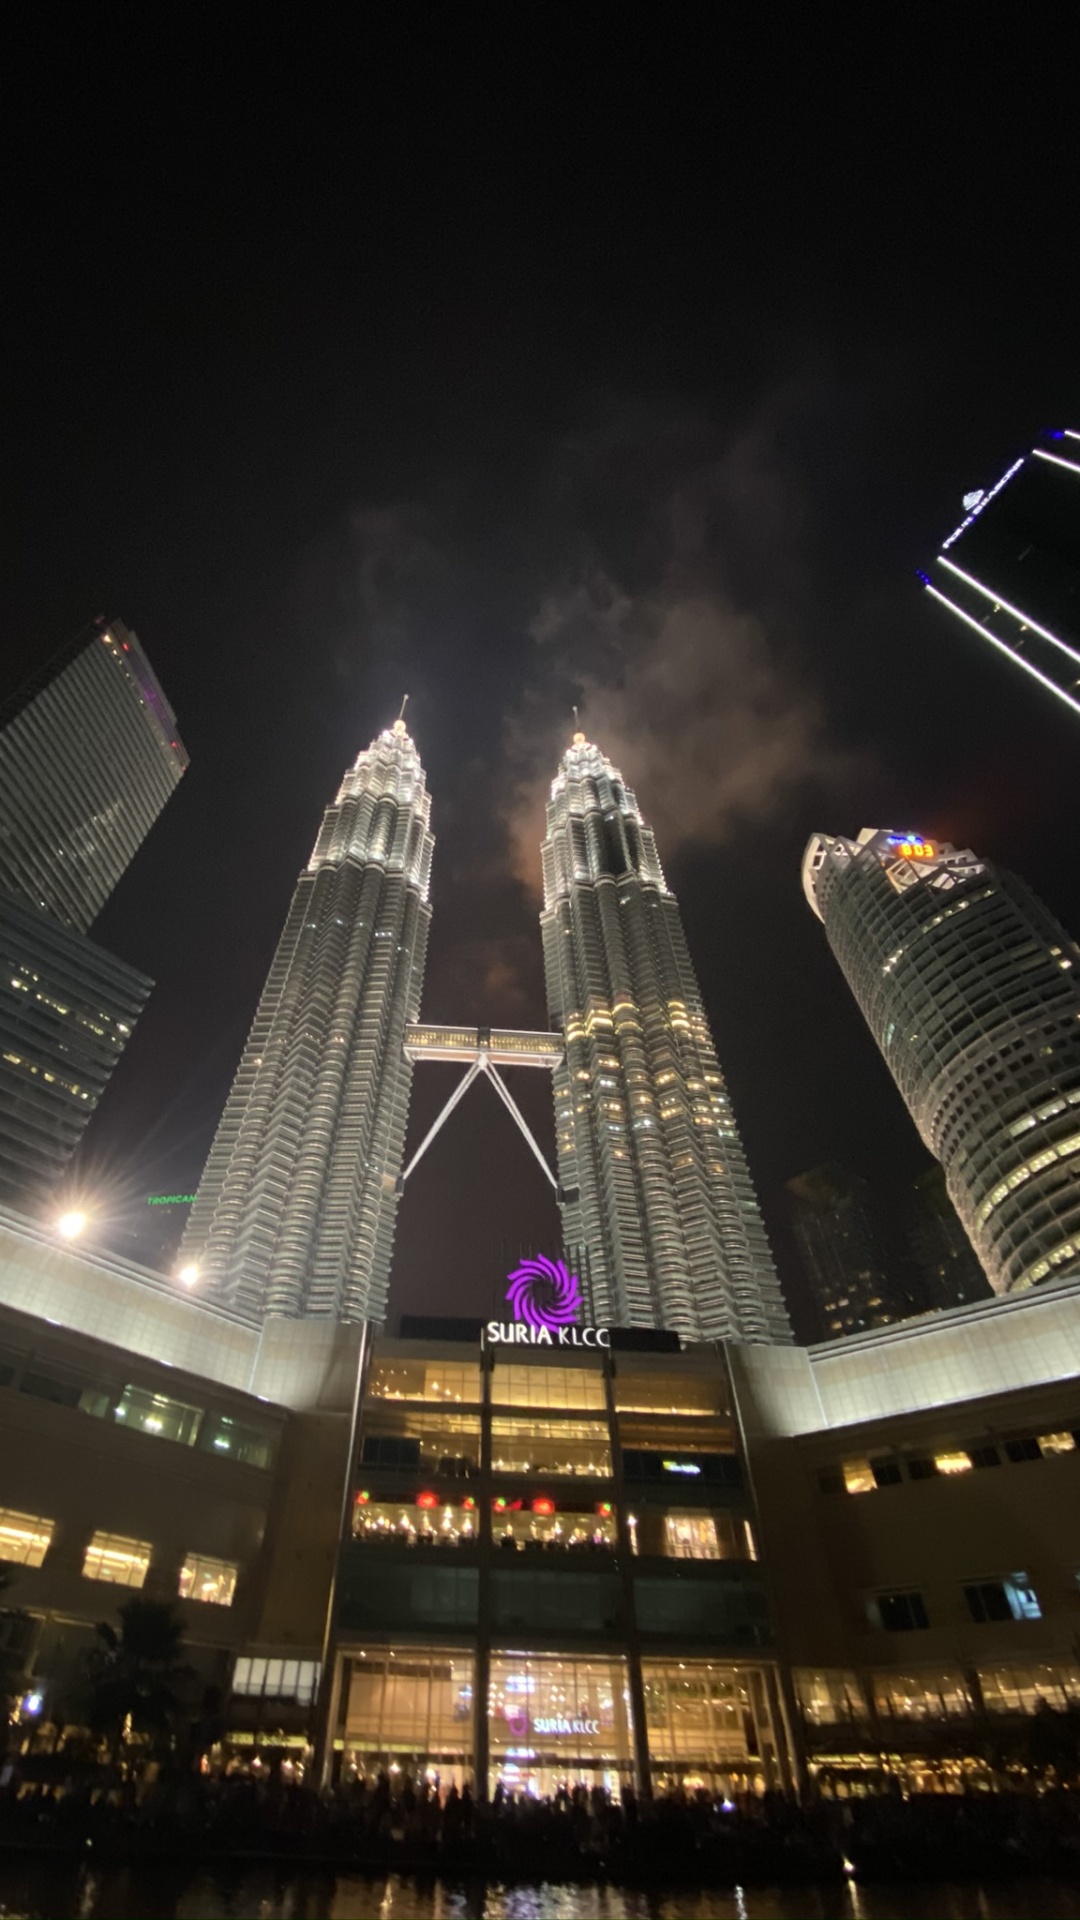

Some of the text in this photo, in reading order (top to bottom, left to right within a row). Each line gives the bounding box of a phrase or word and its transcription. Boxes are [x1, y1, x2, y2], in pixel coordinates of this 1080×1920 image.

[487, 1321, 610, 1348] SURIA KLCC
[533, 1717, 600, 1735] SURIA KLCC
